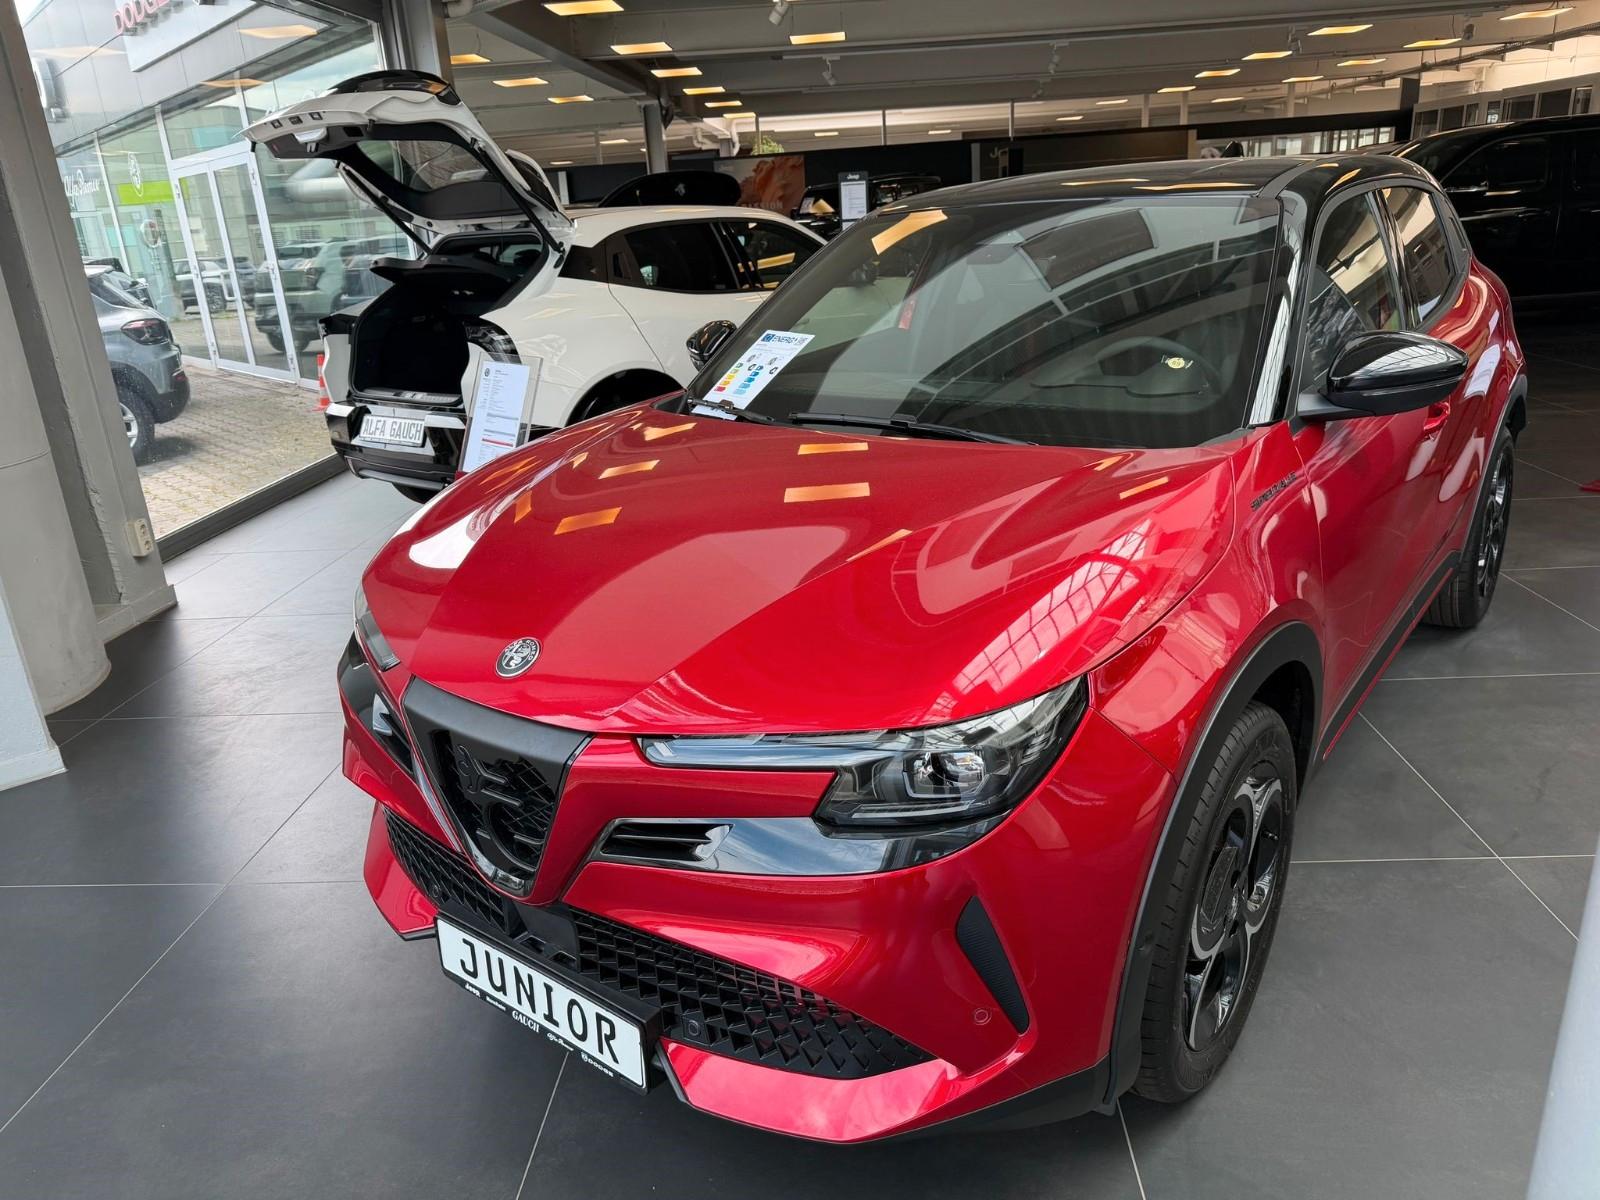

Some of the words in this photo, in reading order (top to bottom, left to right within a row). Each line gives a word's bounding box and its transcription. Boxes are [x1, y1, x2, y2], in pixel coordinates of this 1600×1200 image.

[362, 418, 386, 436] ALFA
[389, 420, 424, 442] GAUCH
[459, 937, 620, 1065] JUNIOR
[511, 1010, 541, 1033] GAUCH
